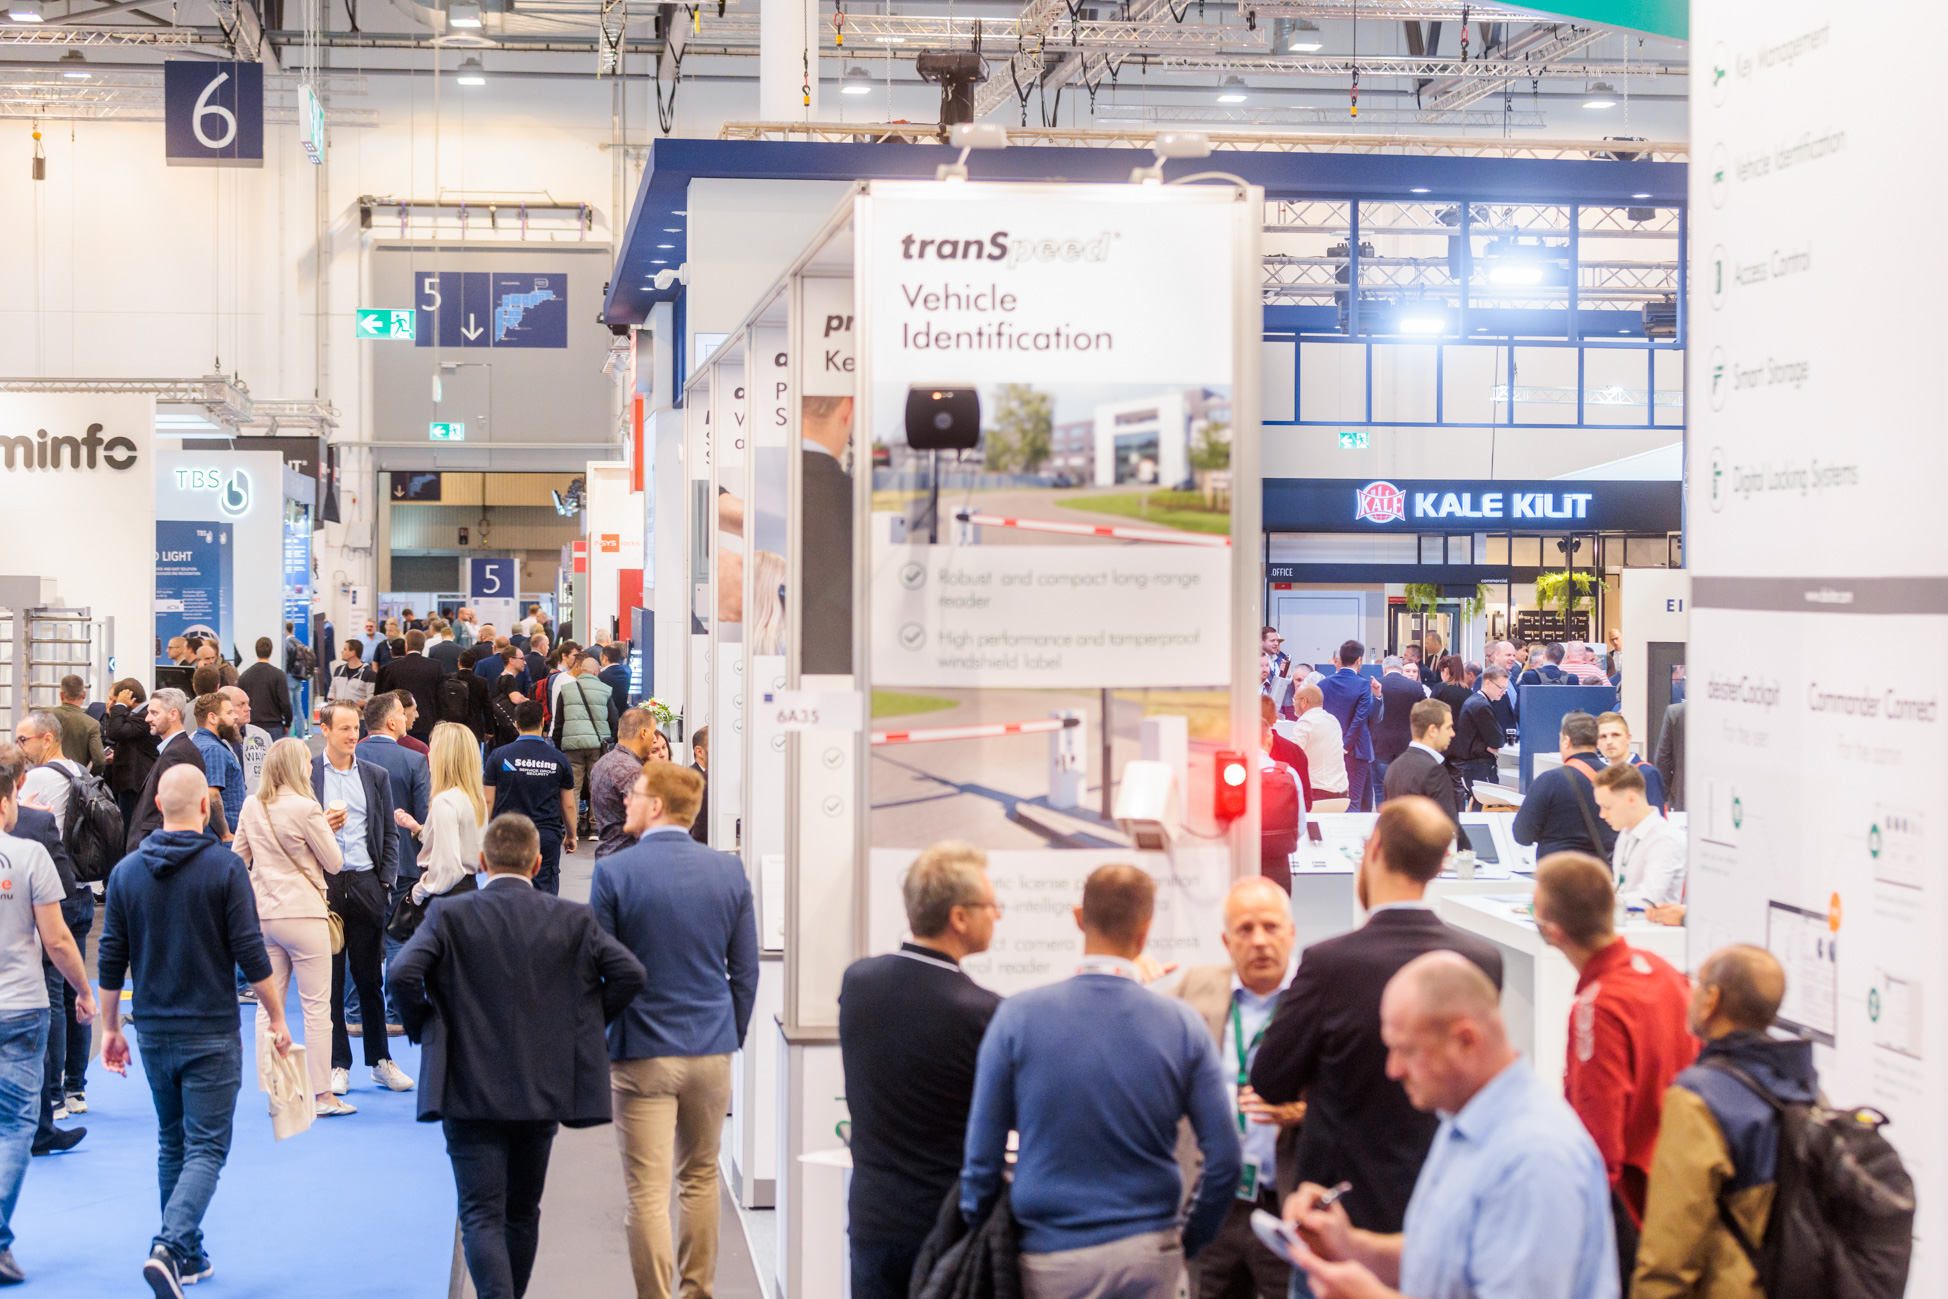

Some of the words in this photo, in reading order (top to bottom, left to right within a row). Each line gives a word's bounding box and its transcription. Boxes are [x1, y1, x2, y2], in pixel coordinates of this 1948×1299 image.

[1757, 19, 1831, 69] Management
[192, 71, 237, 149] 6
[1734, 147, 1771, 182] Vehicle
[1774, 125, 1847, 172] Identification
[1733, 260, 1768, 287] Access
[1771, 241, 1812, 279] Control
[421, 278, 442, 311] 5
[901, 283, 1017, 312] Vehicle
[903, 321, 1113, 350] Identification
[1733, 361, 1764, 390] Smart
[1767, 357, 1809, 390] Storage
[175, 470, 220, 489] TBS
[1733, 463, 1765, 500] Digital
[1768, 460, 1808, 497] Locking
[1810, 457, 1860, 496] Systems
[1361, 496, 1403, 516] KALE
[1415, 492, 1503, 518] KALE
[162, 551, 193, 562] LIGHT
[482, 565, 501, 594] 5
[938, 569, 993, 586] Robust
[1000, 568, 1034, 586] and
[1037, 569, 1108, 588] compact
[1112, 568, 1201, 590] long-range
[938, 592, 991, 608] reader
[938, 628, 974, 649] High
[977, 629, 1073, 649] performance
[1076, 629, 1106, 646] and
[937, 653, 1018, 670] windshield
[1023, 653, 1062, 670] label
[1808, 682, 1881, 718] Commander
[1884, 688, 1938, 723] Connect
[514, 758, 557, 770] Stölting
[1019, 874, 1069, 891] license
[998, 959, 1051, 974] reader
